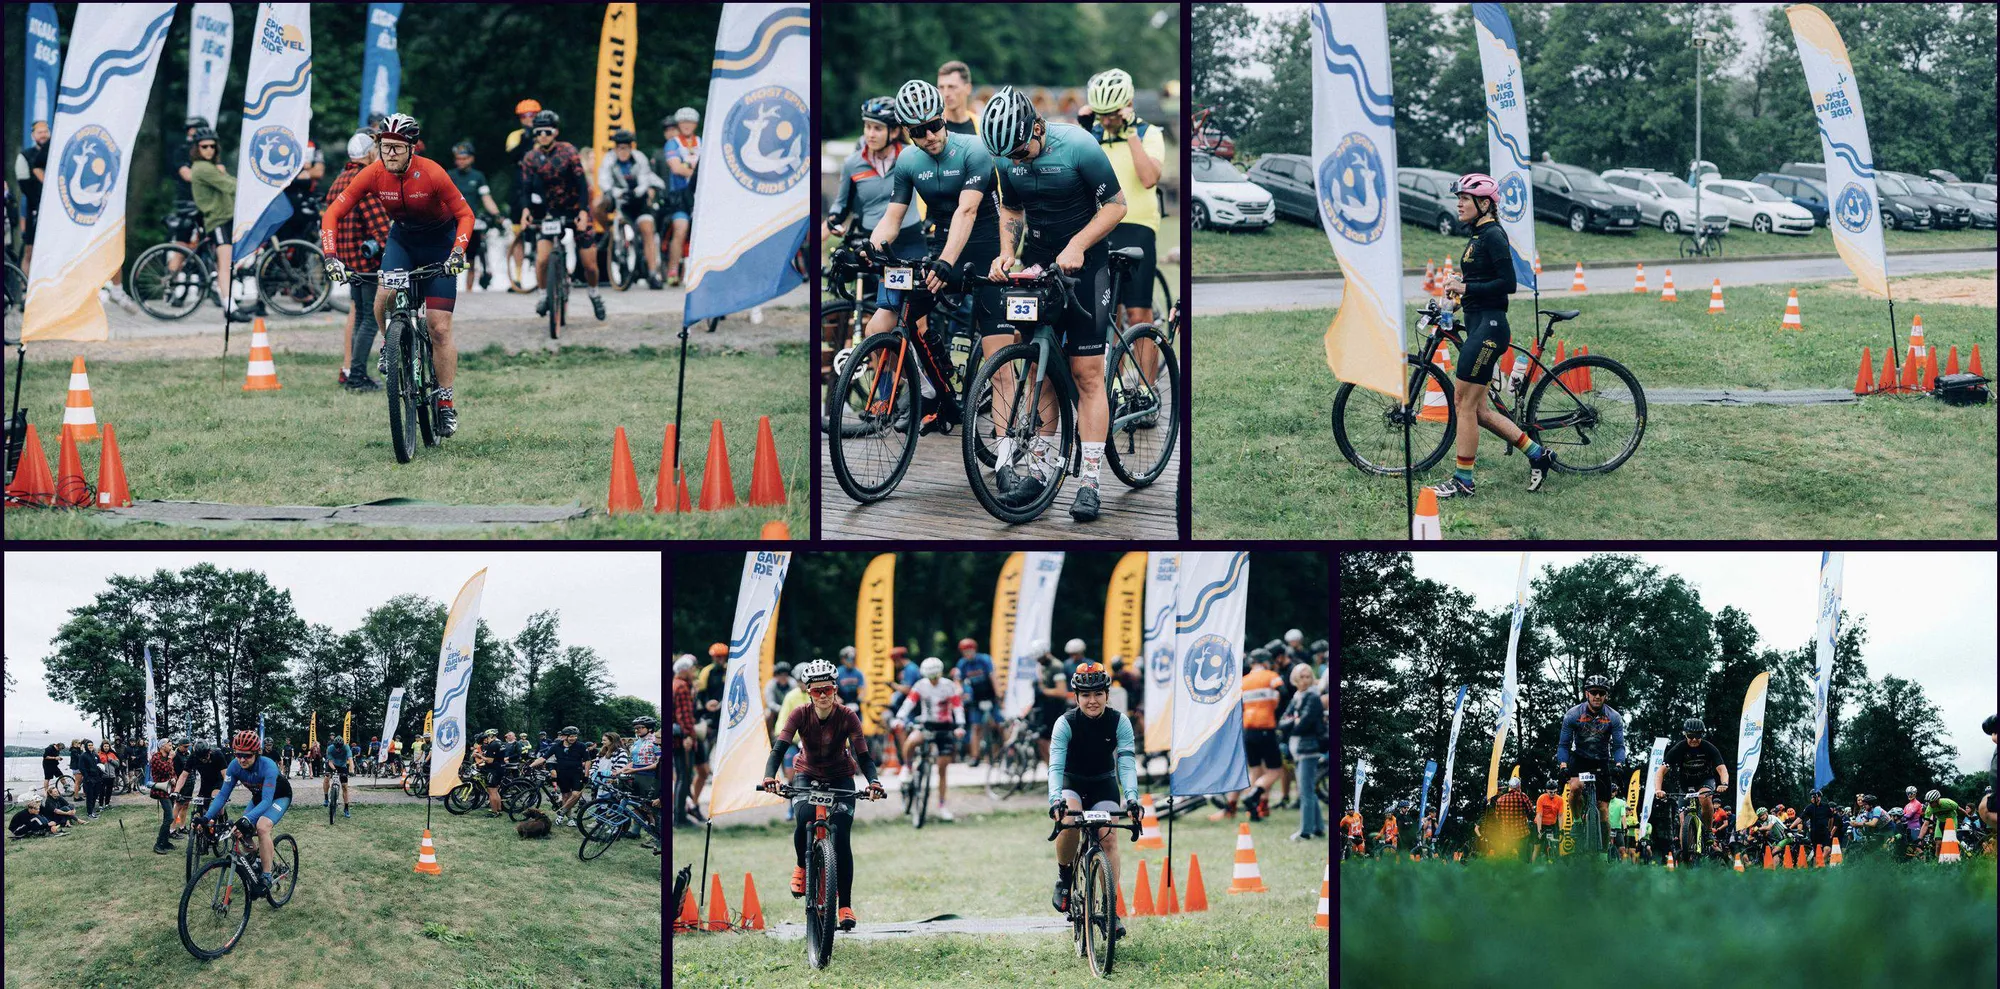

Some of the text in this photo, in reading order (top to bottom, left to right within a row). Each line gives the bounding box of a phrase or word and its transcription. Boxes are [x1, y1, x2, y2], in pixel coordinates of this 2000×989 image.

[266, 18, 284, 36] EPIC
[261, 36, 283, 54] RIDE
[263, 27, 305, 51] GRAVEL
[889, 274, 905, 284] 34
[1014, 304, 1031, 315] 33
